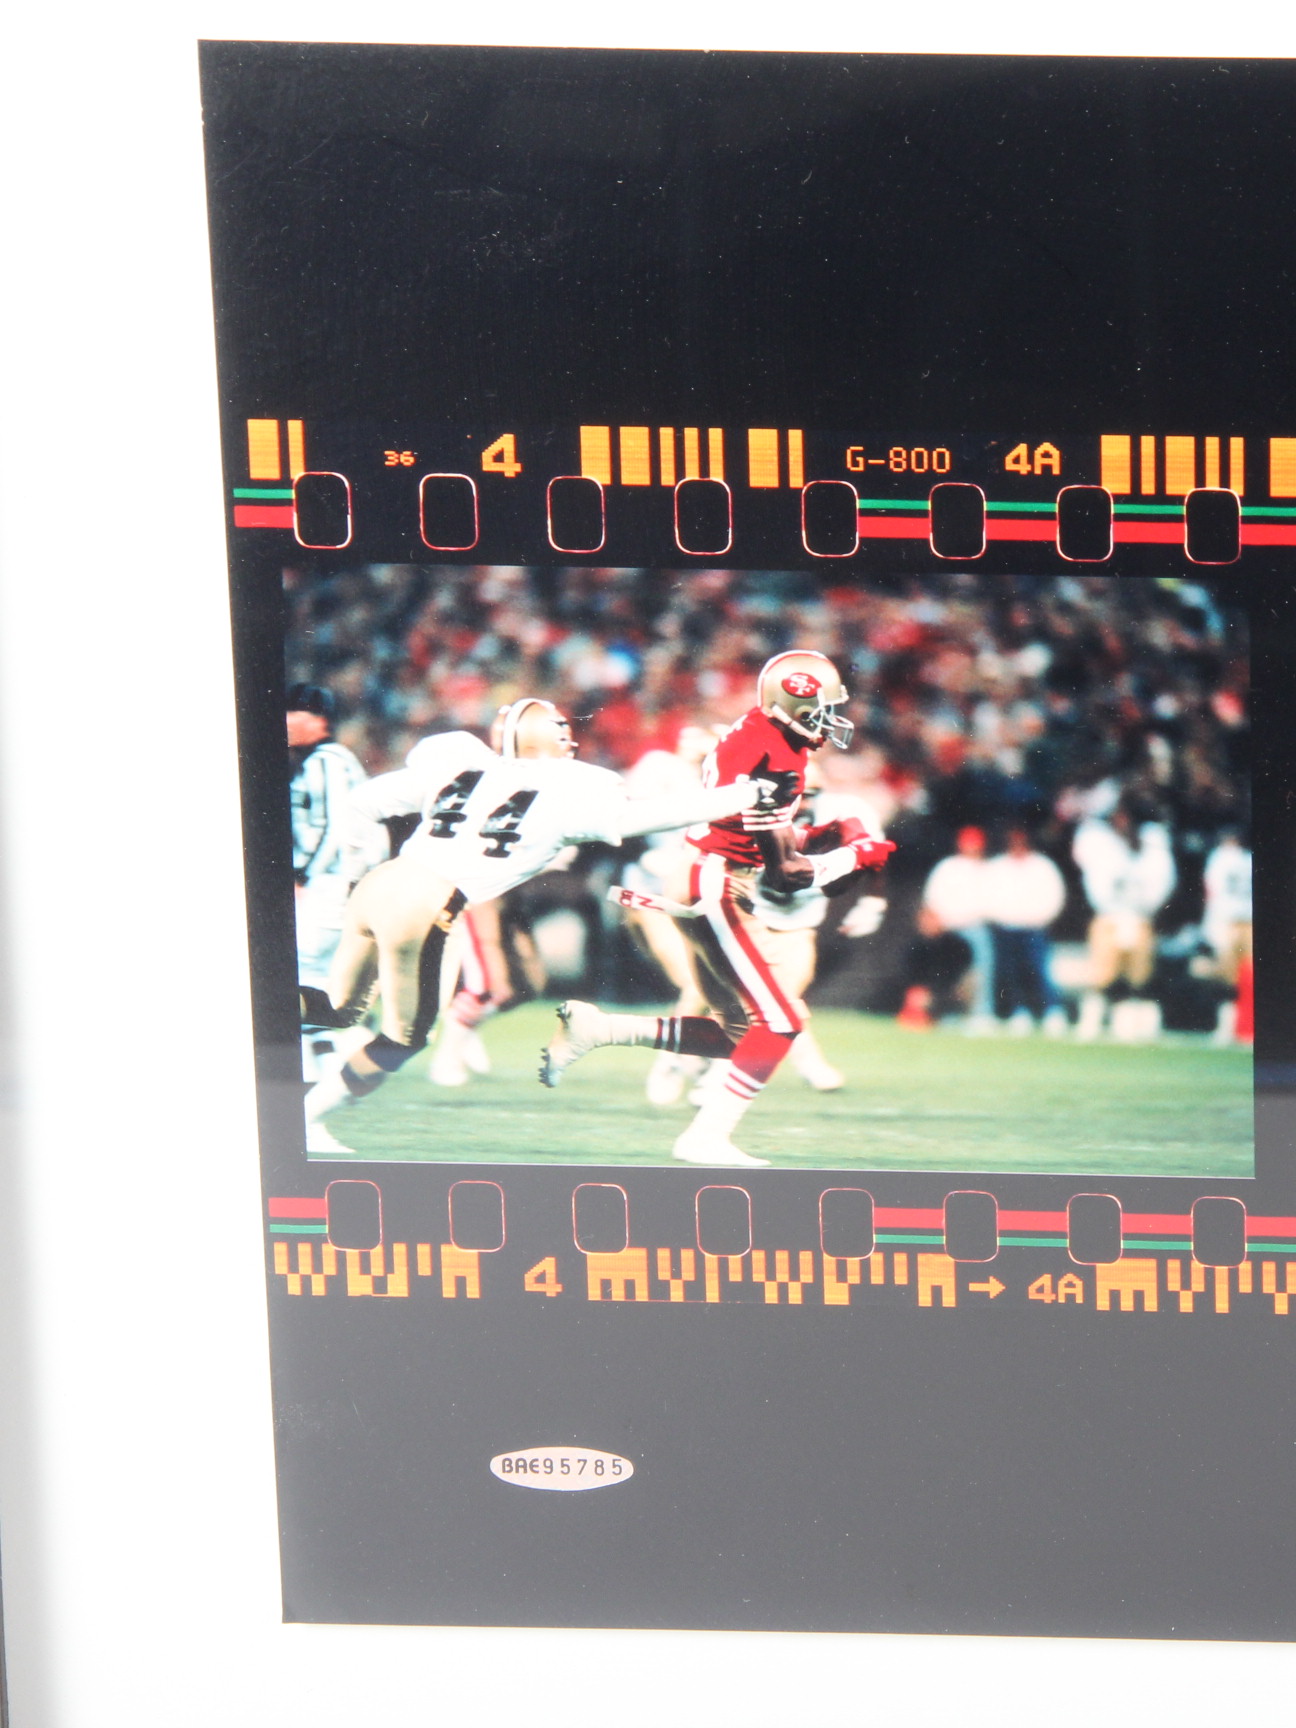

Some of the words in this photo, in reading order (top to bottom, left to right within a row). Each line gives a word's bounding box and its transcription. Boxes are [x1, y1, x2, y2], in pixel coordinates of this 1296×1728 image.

[384, 450, 416, 467] 36
[481, 433, 523, 478] 4
[845, 446, 952, 475] G-800
[1003, 442, 1062, 476] 4A
[429, 770, 539, 858] 44
[524, 1256, 564, 1298] 4
[1028, 1273, 1084, 1304] 4A
[501, 1457, 623, 1477] BAE95785
